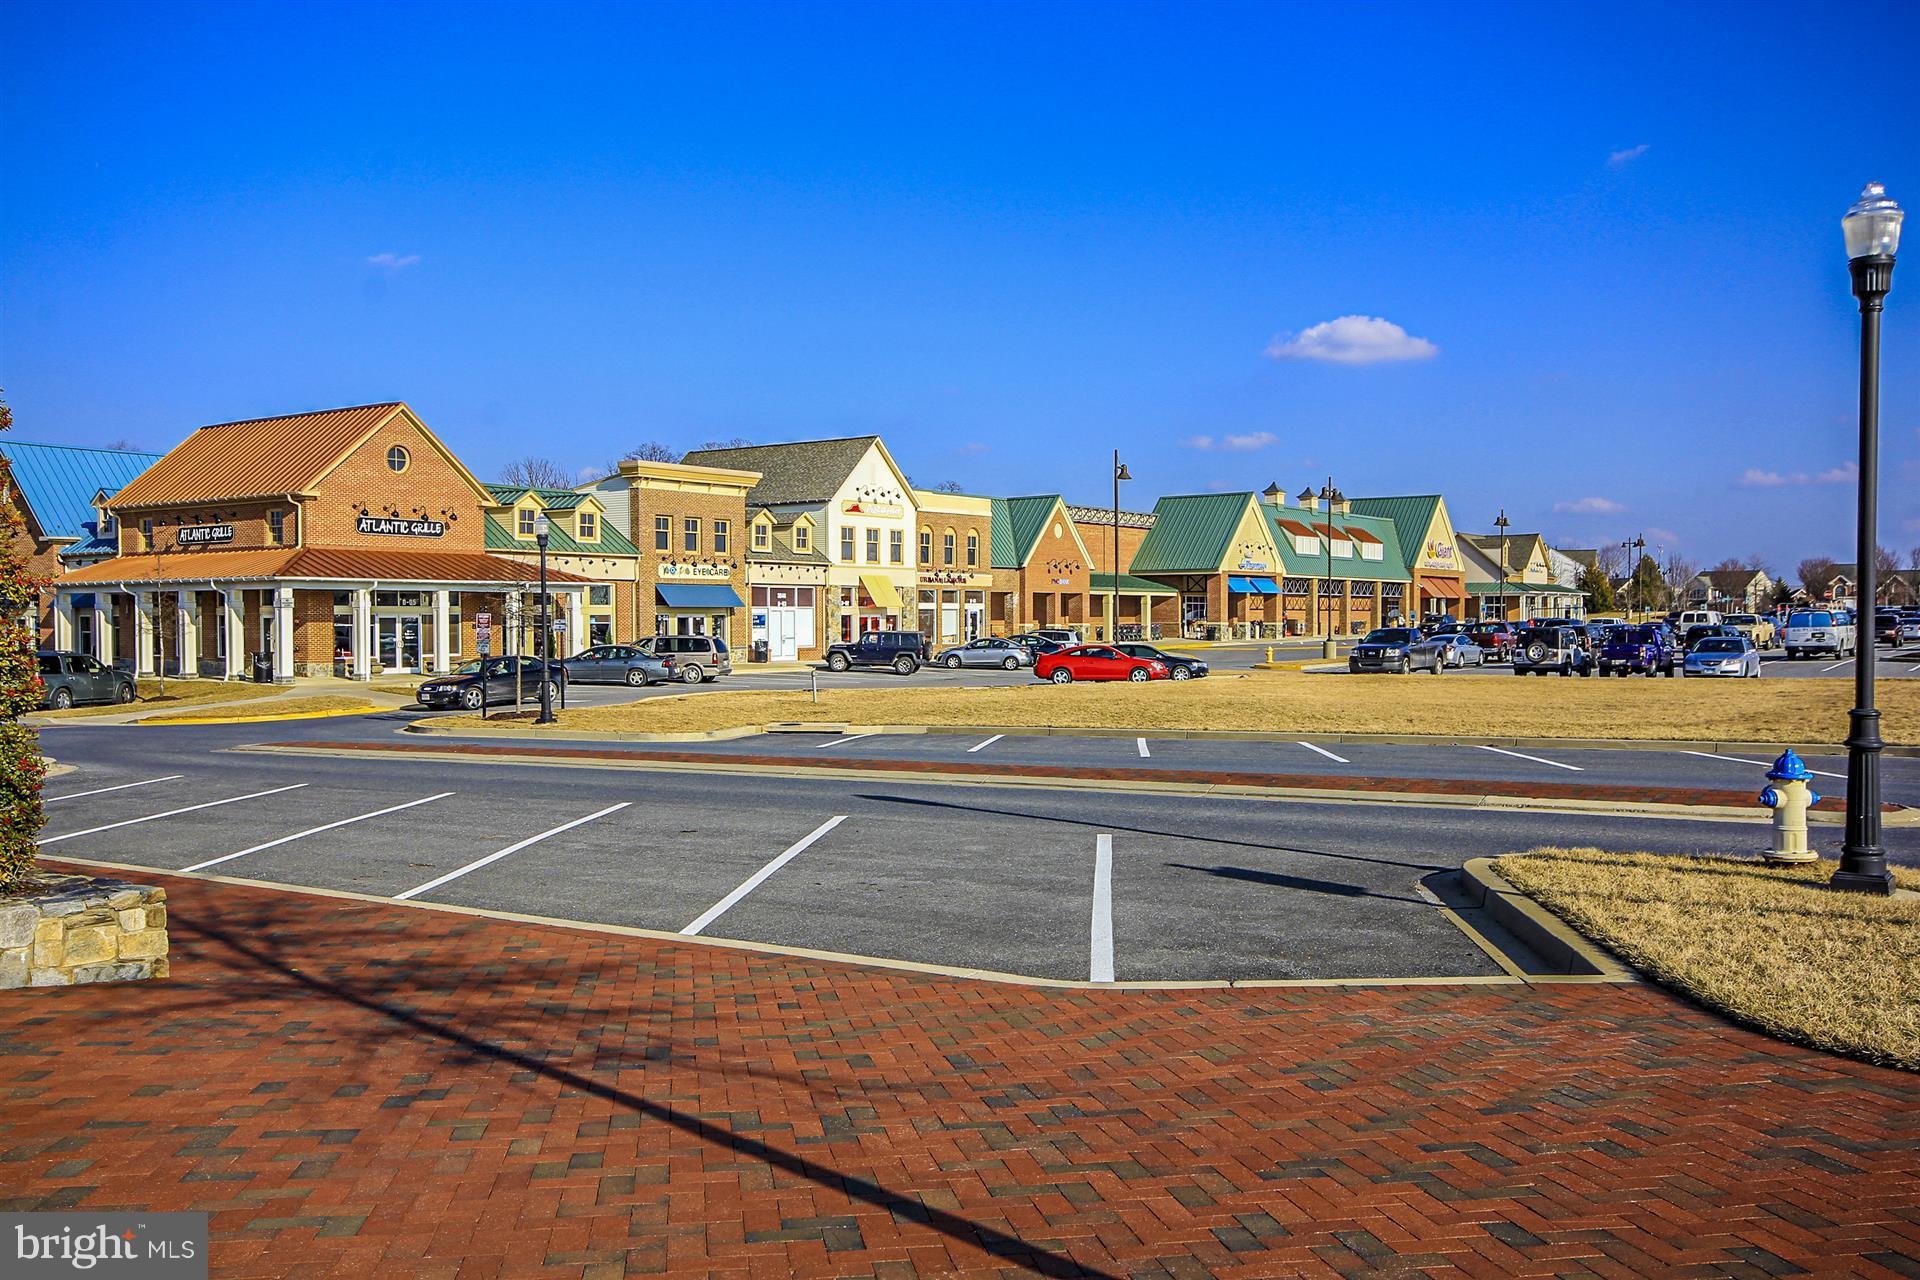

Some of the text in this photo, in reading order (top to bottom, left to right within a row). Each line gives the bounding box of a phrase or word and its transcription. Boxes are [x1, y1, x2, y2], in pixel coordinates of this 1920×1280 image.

[180, 526, 233, 541] ATLANTIC GRILLE
[358, 518, 442, 535] ATLANTIC GRILLE
[693, 567, 706, 576] EYE
